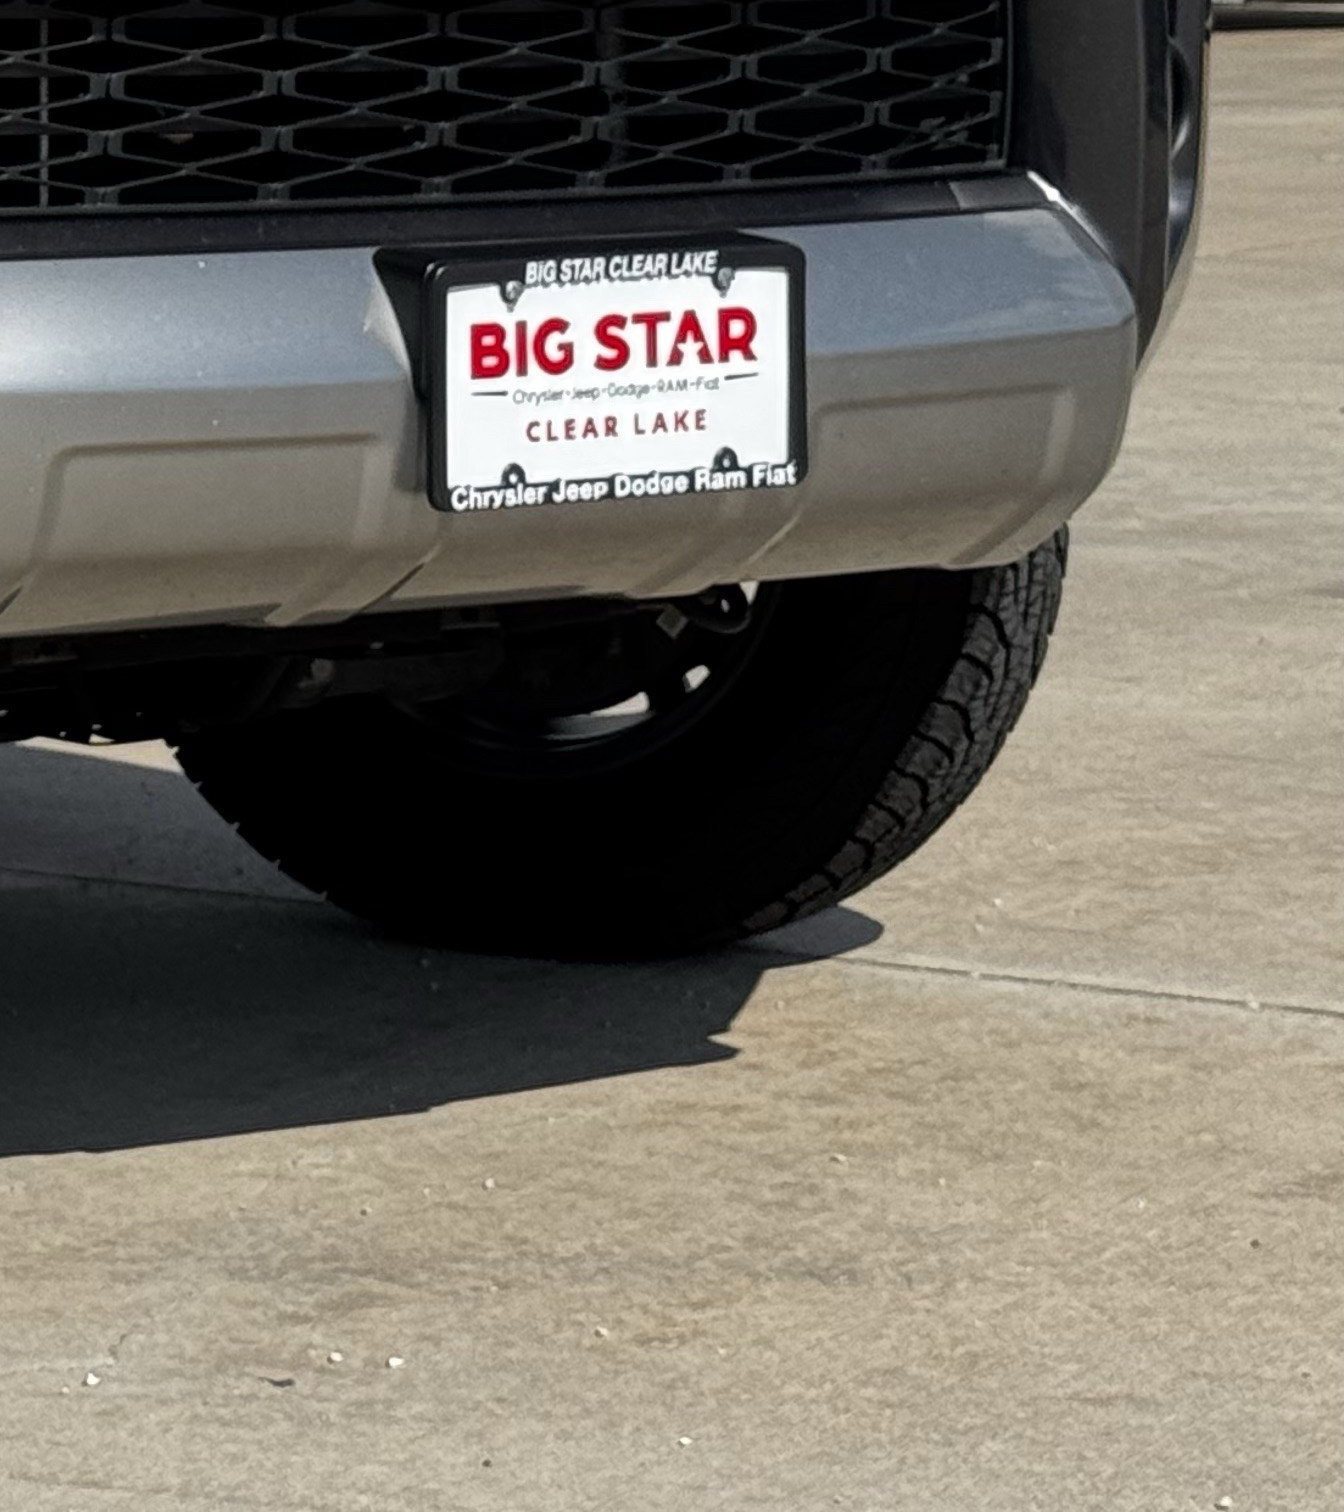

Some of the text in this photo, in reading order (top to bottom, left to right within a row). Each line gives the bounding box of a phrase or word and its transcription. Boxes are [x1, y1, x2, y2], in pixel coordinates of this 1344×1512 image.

[524, 249, 719, 286] BIG STAR CLEAR LAKE
[469, 305, 759, 380] BIG STAR
[525, 408, 708, 443] CLEAR LAKE
[450, 460, 799, 512] Chrysler Jeep Dodge Ram Fiat
